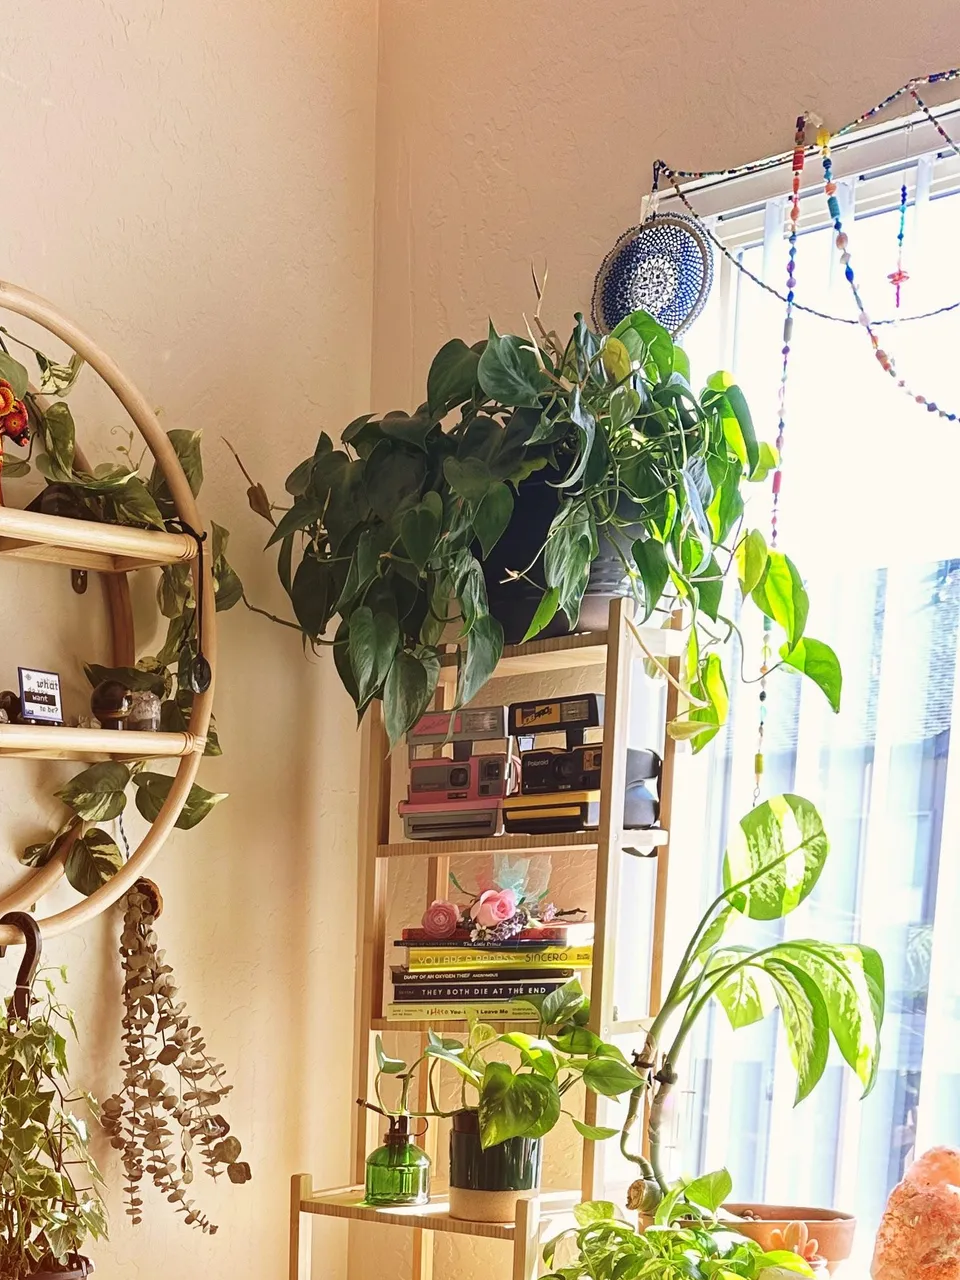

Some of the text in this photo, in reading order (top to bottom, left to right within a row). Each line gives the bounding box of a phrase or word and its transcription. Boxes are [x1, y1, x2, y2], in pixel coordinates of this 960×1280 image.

[36, 680, 58, 690] what
[32, 694, 48, 702] want
[527, 759, 549, 767] Polaroid
[418, 956, 440, 965] YOU
[443, 955, 463, 964] ARE
[525, 952, 568, 962] SINCERO
